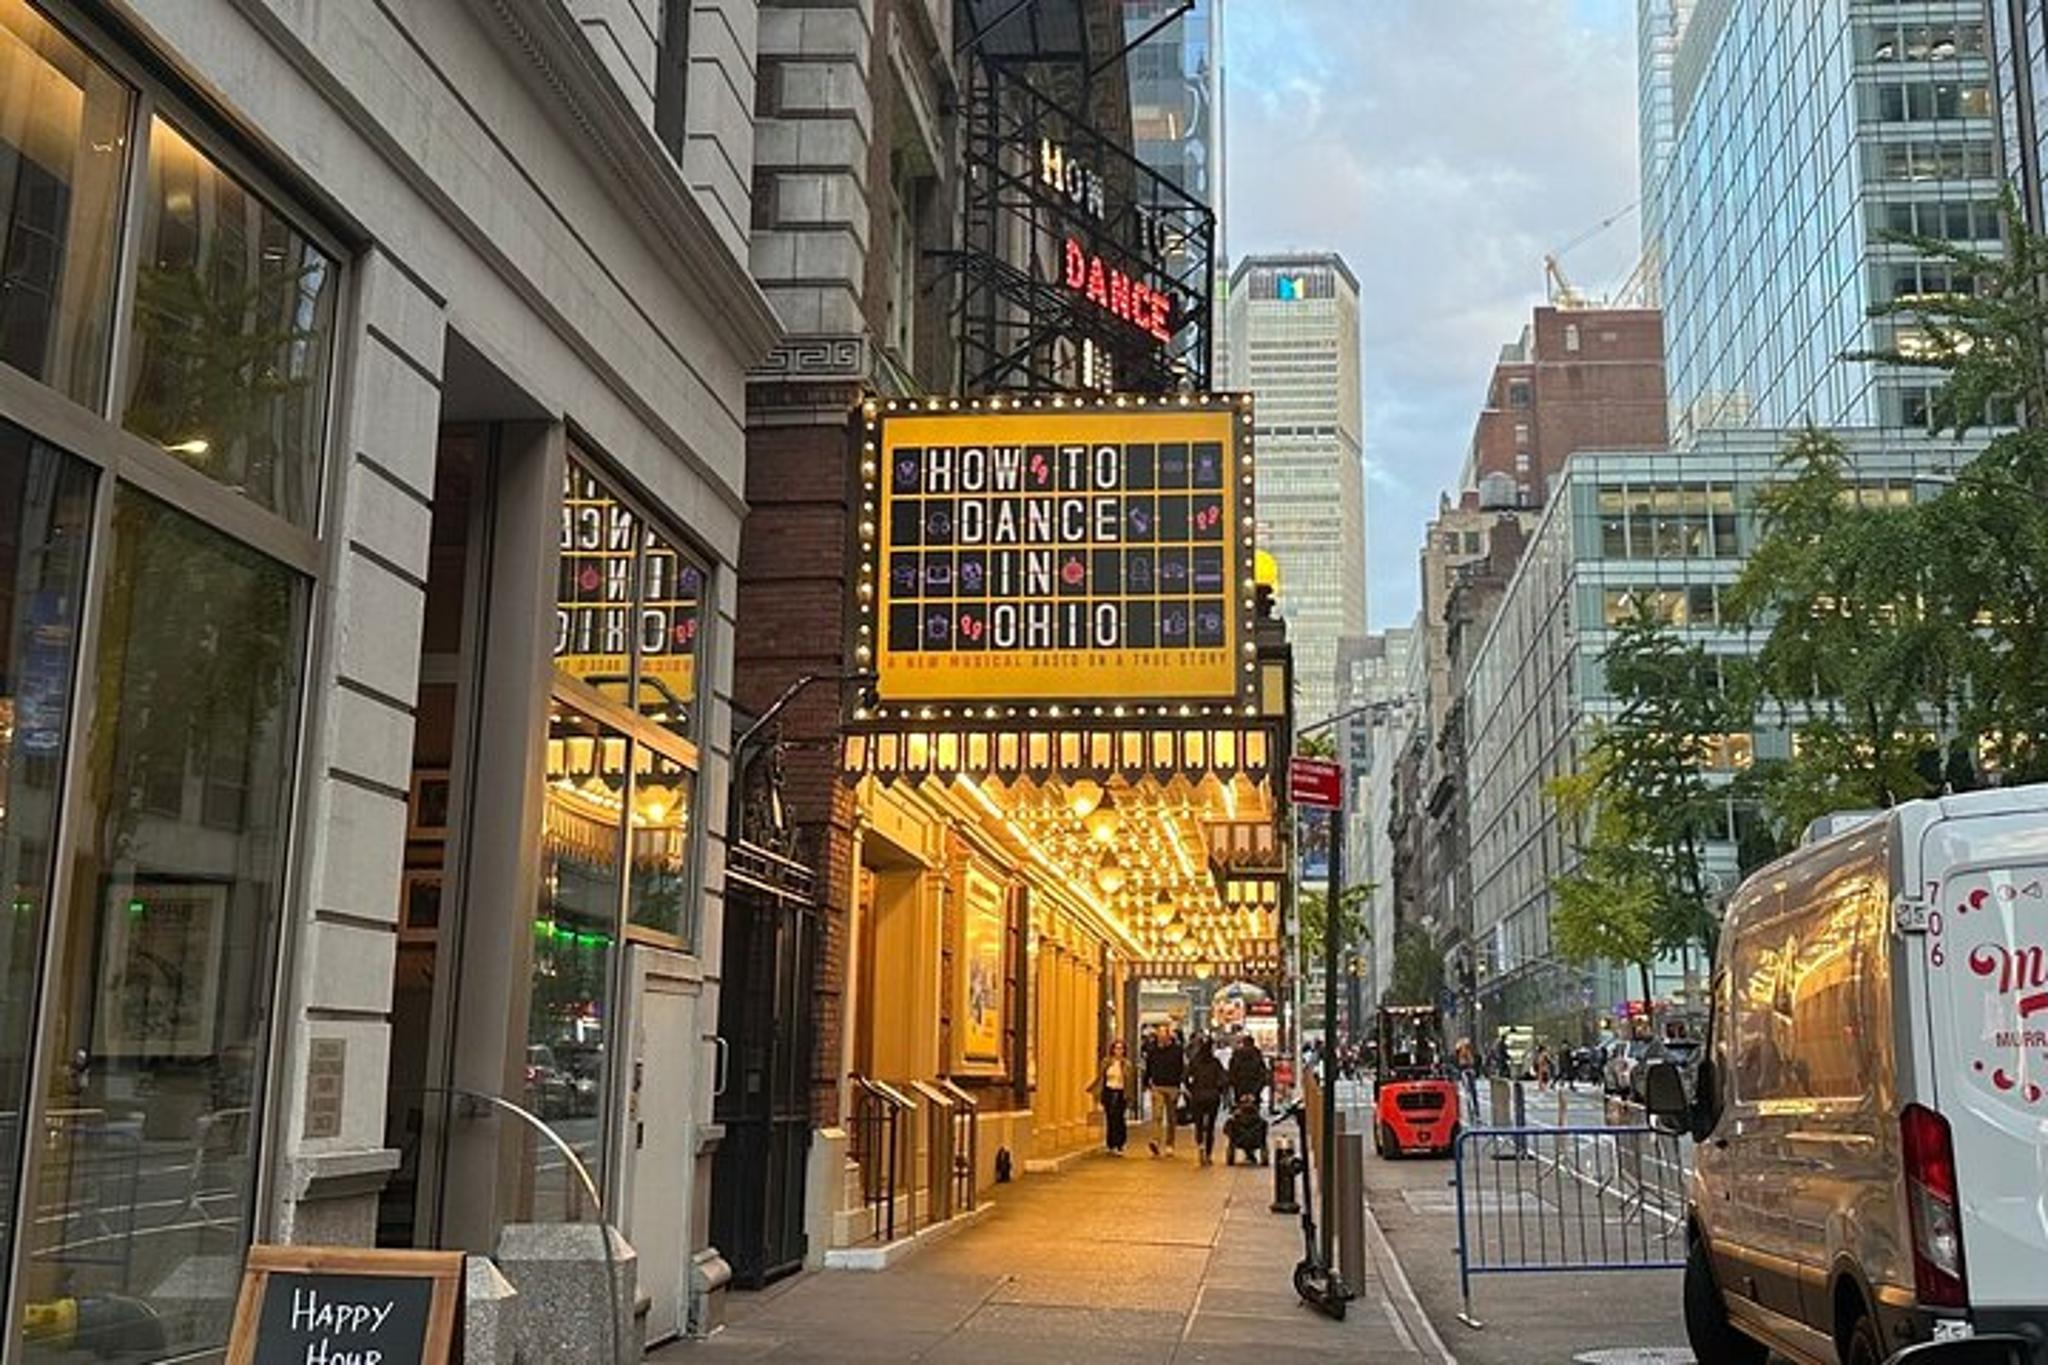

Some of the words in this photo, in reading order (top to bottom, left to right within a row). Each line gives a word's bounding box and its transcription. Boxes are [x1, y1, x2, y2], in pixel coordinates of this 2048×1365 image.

[1065, 237, 1171, 343] DANCE
[929, 448, 1022, 491] HOW
[1063, 447, 1118, 489] TO
[962, 498, 1118, 542] DANCE
[1001, 551, 1051, 595] IN
[994, 602, 1118, 647] OHIO
[1996, 1031, 2048, 1047] MURR
